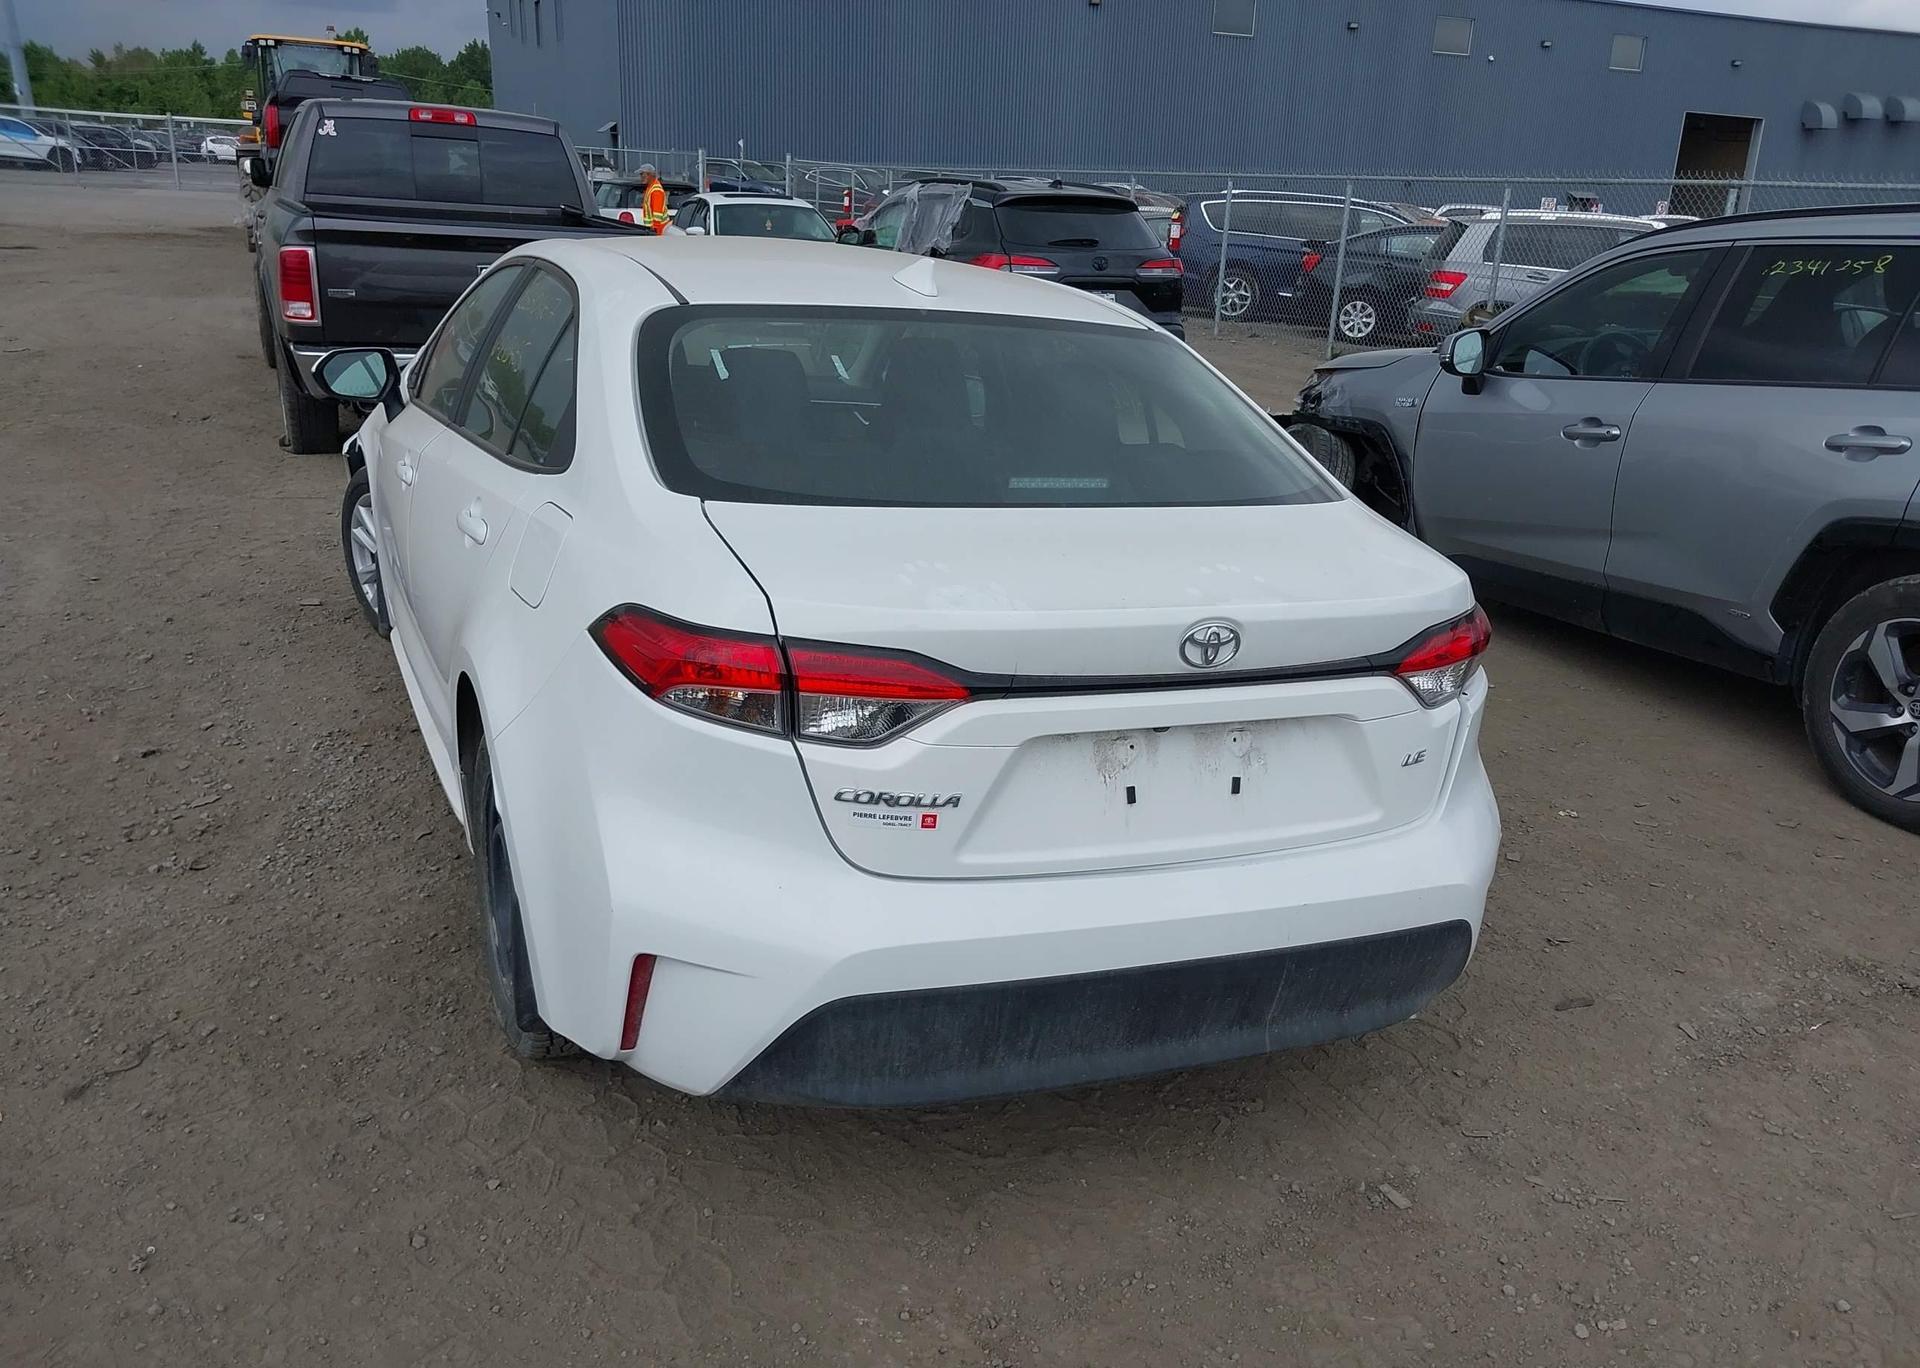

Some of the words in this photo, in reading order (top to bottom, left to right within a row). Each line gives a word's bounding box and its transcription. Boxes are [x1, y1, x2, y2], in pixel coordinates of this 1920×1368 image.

[1401, 748, 1427, 767] LE
[833, 787, 963, 809] COROLLA
[852, 811, 877, 820] PIERRE
[878, 814, 913, 822] LEFEBVRE
